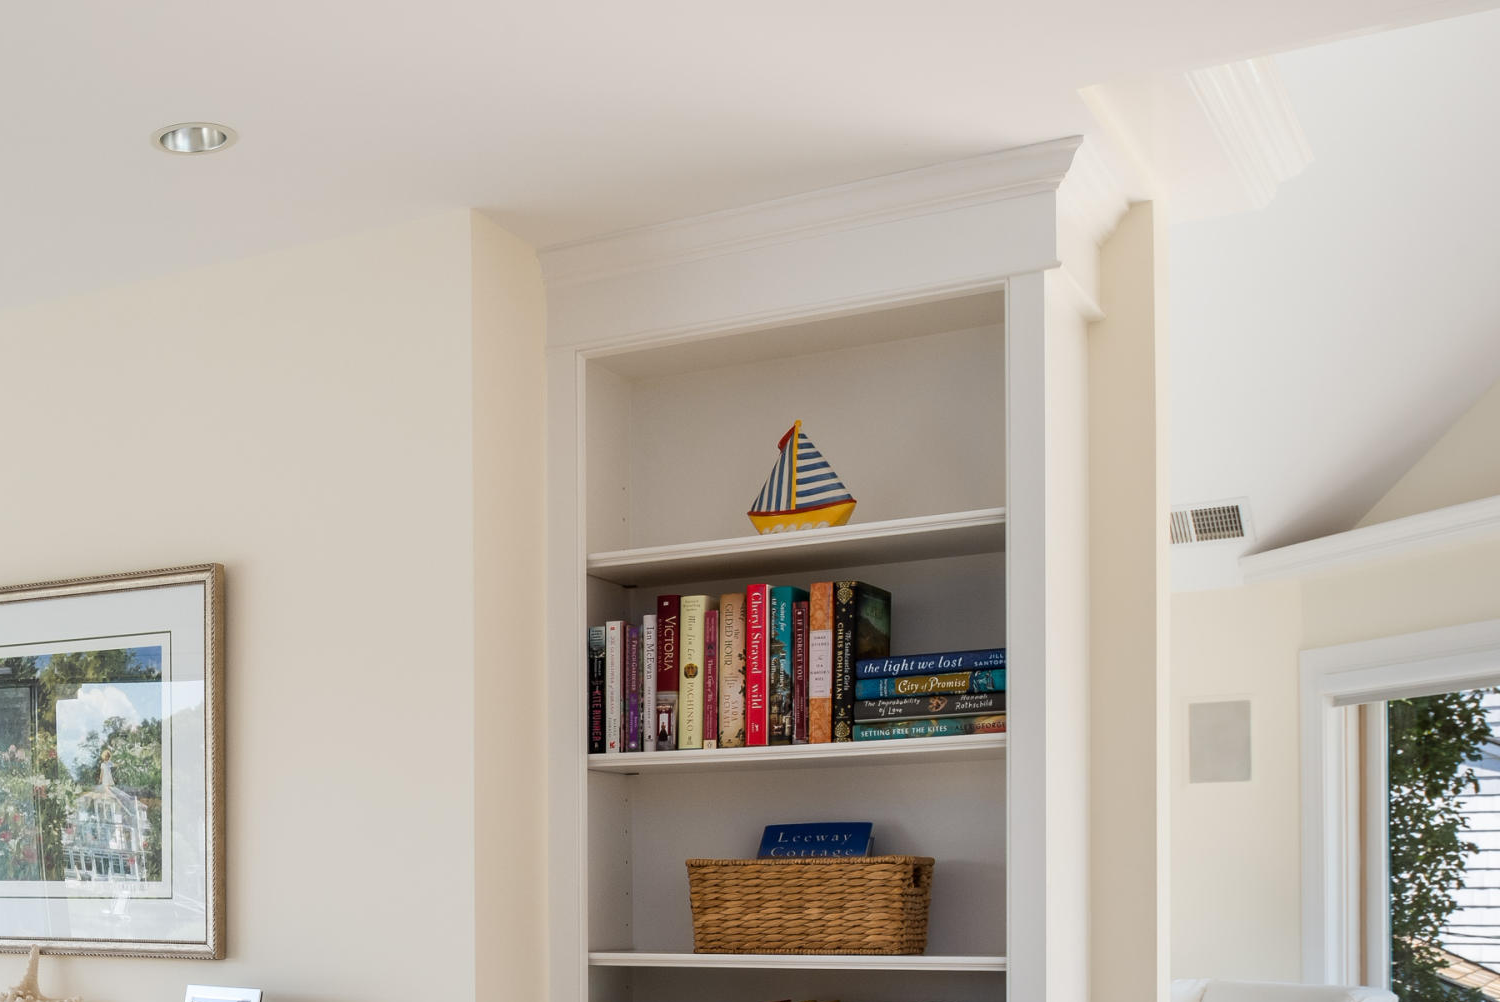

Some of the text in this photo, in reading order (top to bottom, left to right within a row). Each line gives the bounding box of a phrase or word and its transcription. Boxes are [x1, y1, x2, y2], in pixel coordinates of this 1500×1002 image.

[797, 618, 803, 626] IF
[724, 604, 733, 666] GILDED HOUR
[749, 592, 762, 674] Cheryl Strayed
[664, 616, 677, 671] VICTORIA
[646, 626, 655, 680] Ian McEwan
[864, 656, 964, 676] the light we lost
[898, 679, 919, 693] City
[928, 676, 966, 691] Promise
[752, 684, 762, 709] wild
[878, 698, 921, 708] Improbability
[955, 700, 993, 710] Rothschild
[686, 682, 694, 732] PACHINKO
[879, 707, 903, 716] of Love
[927, 725, 948, 733] KITES
[778, 832, 852, 845] Leeway
[770, 847, 853, 858] Cottage
